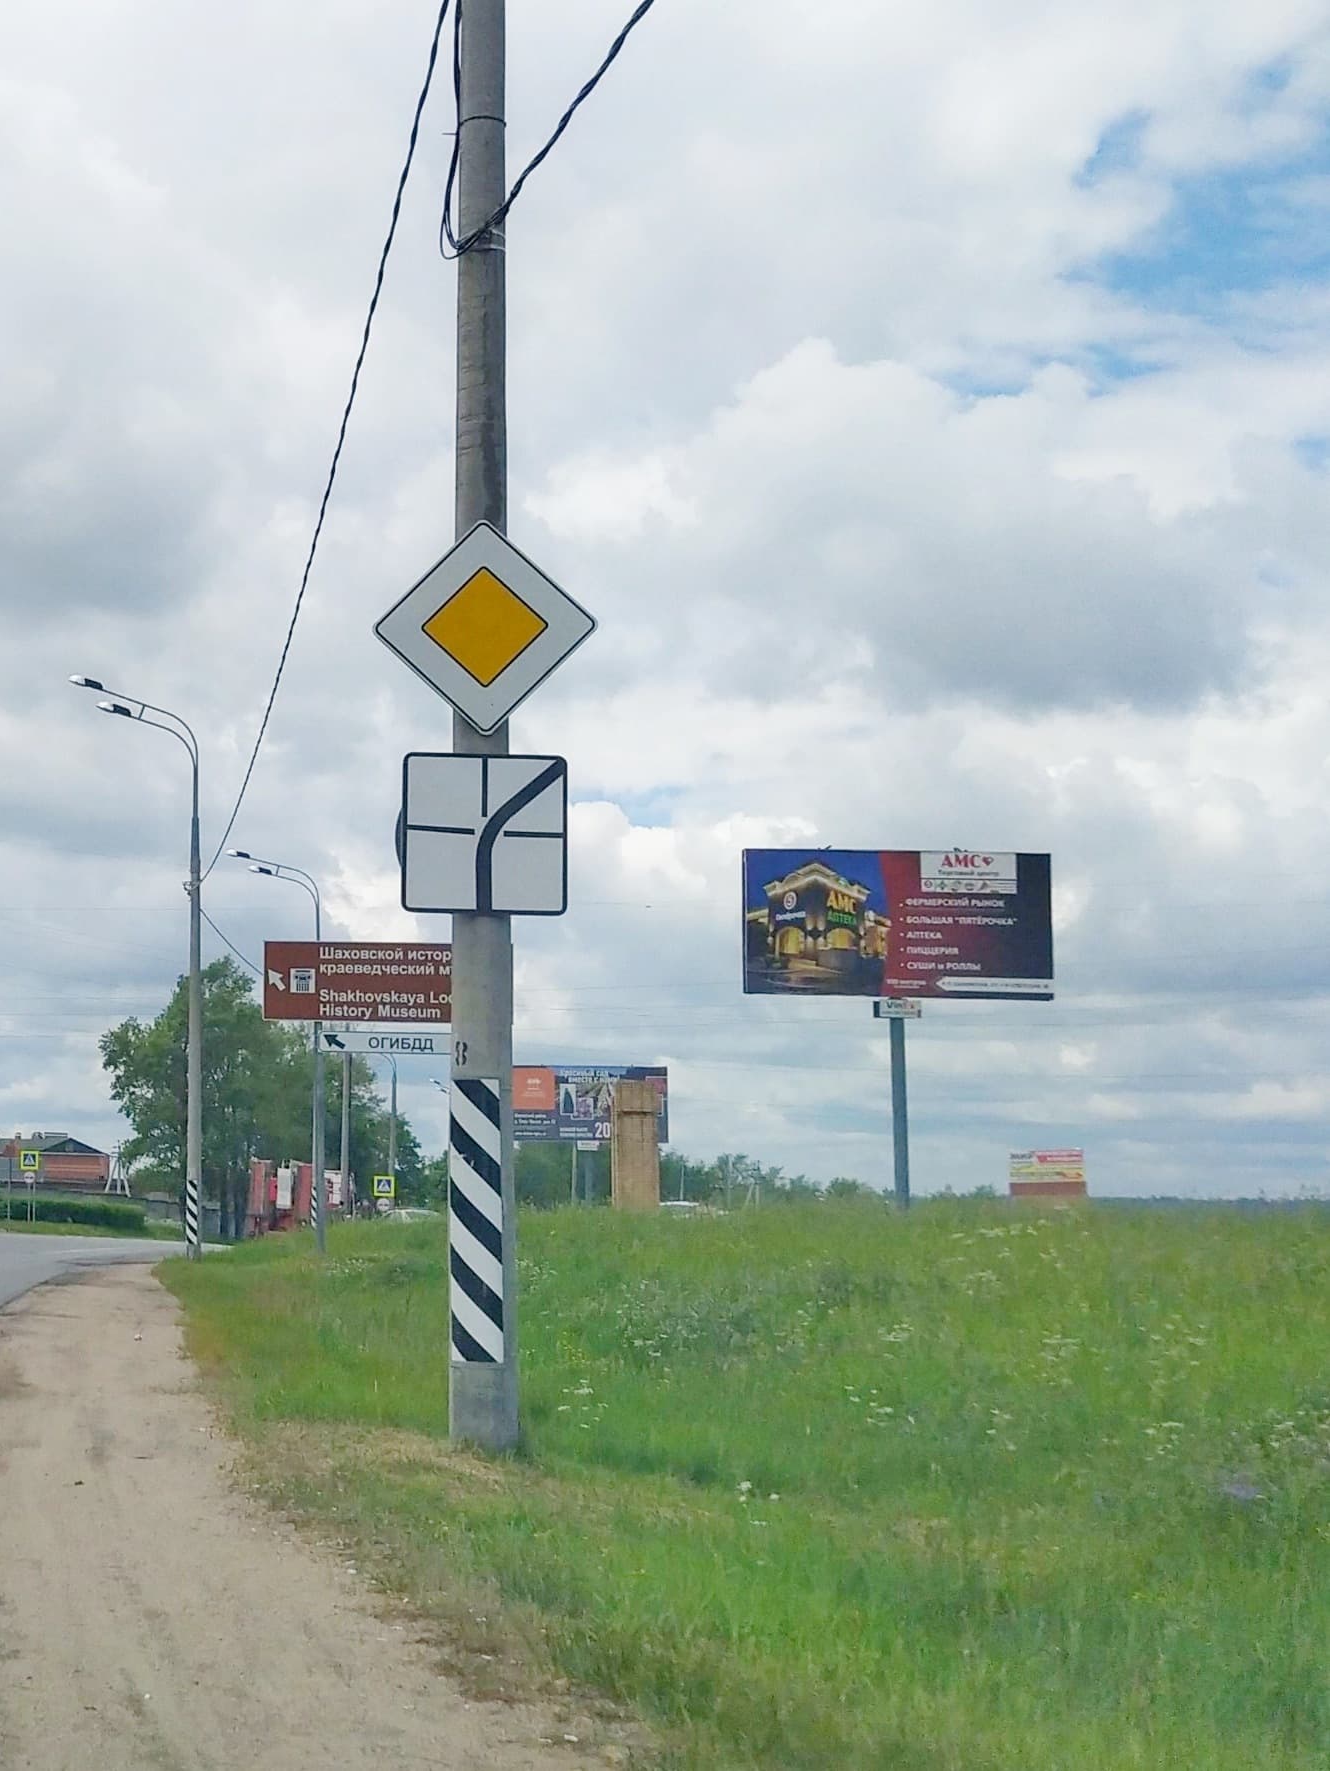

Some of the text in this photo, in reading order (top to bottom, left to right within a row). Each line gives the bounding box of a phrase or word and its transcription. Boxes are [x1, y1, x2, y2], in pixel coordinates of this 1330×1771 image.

[906, 931, 942, 939] АПТЕКА
[319, 946, 451, 962] Шаховской истор
[319, 963, 434, 976] краеведческий
[907, 962, 936, 970] СУШИ
[946, 962, 982, 971] РОЛЛЫ
[319, 989, 425, 1006] Shakhovskaya
[319, 1003, 441, 1020] History Museum
[368, 1037, 434, 1052] ОГИБДД
